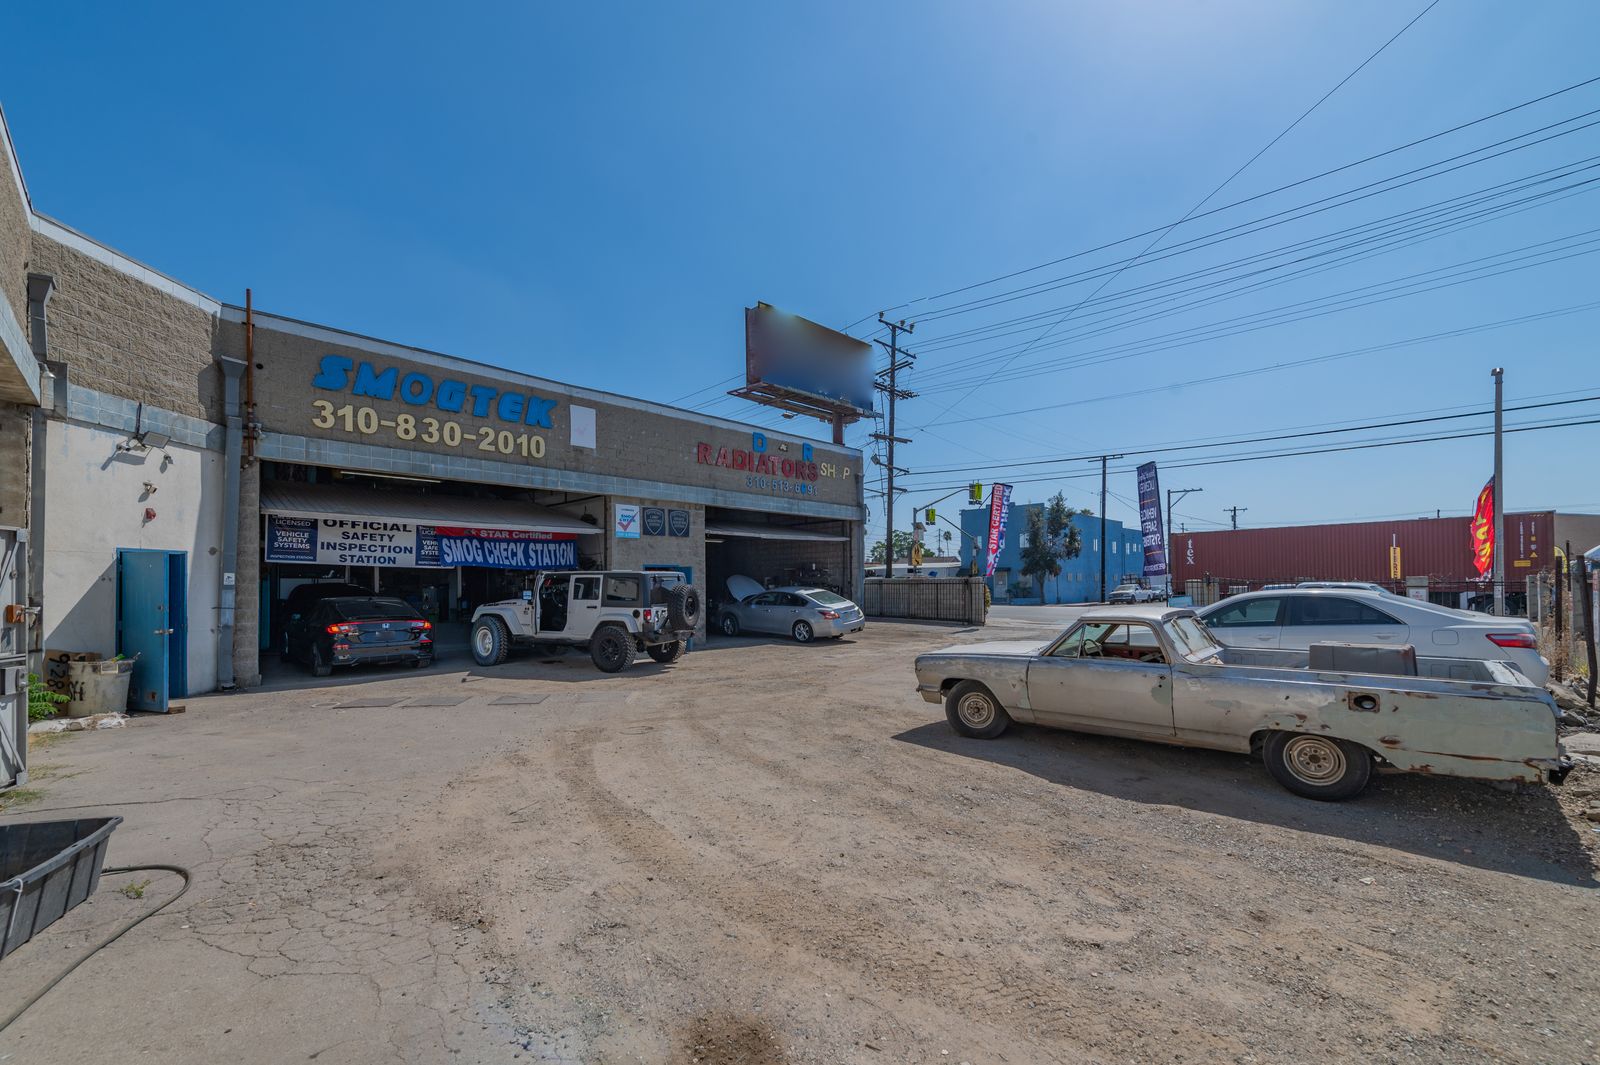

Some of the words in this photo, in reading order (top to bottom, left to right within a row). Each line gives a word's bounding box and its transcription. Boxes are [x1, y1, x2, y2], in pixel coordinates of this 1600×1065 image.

[313, 355, 558, 429] SMOGTEK
[312, 400, 546, 458] 310-830-2010
[752, 432, 767, 453] D
[802, 443, 814, 461] R
[698, 442, 818, 481] RADIATORS
[992, 484, 1003, 527] CERTIFIED
[276, 530, 309, 538] VEHICLE
[322, 519, 412, 533] OFFICIAL
[479, 529, 510, 539] STAR
[512, 531, 553, 540] Certified
[273, 541, 311, 550] SYSTEMS
[277, 536, 308, 544] SAFETY
[341, 531, 396, 543] SAFETY
[988, 529, 999, 550] STAR
[320, 542, 414, 555] INSPECTION
[442, 538, 483, 563] SMOG
[483, 540, 527, 567] CHECK
[528, 542, 574, 567] STATION
[1186, 538, 1195, 565] tex
[339, 554, 397, 565] STATION
